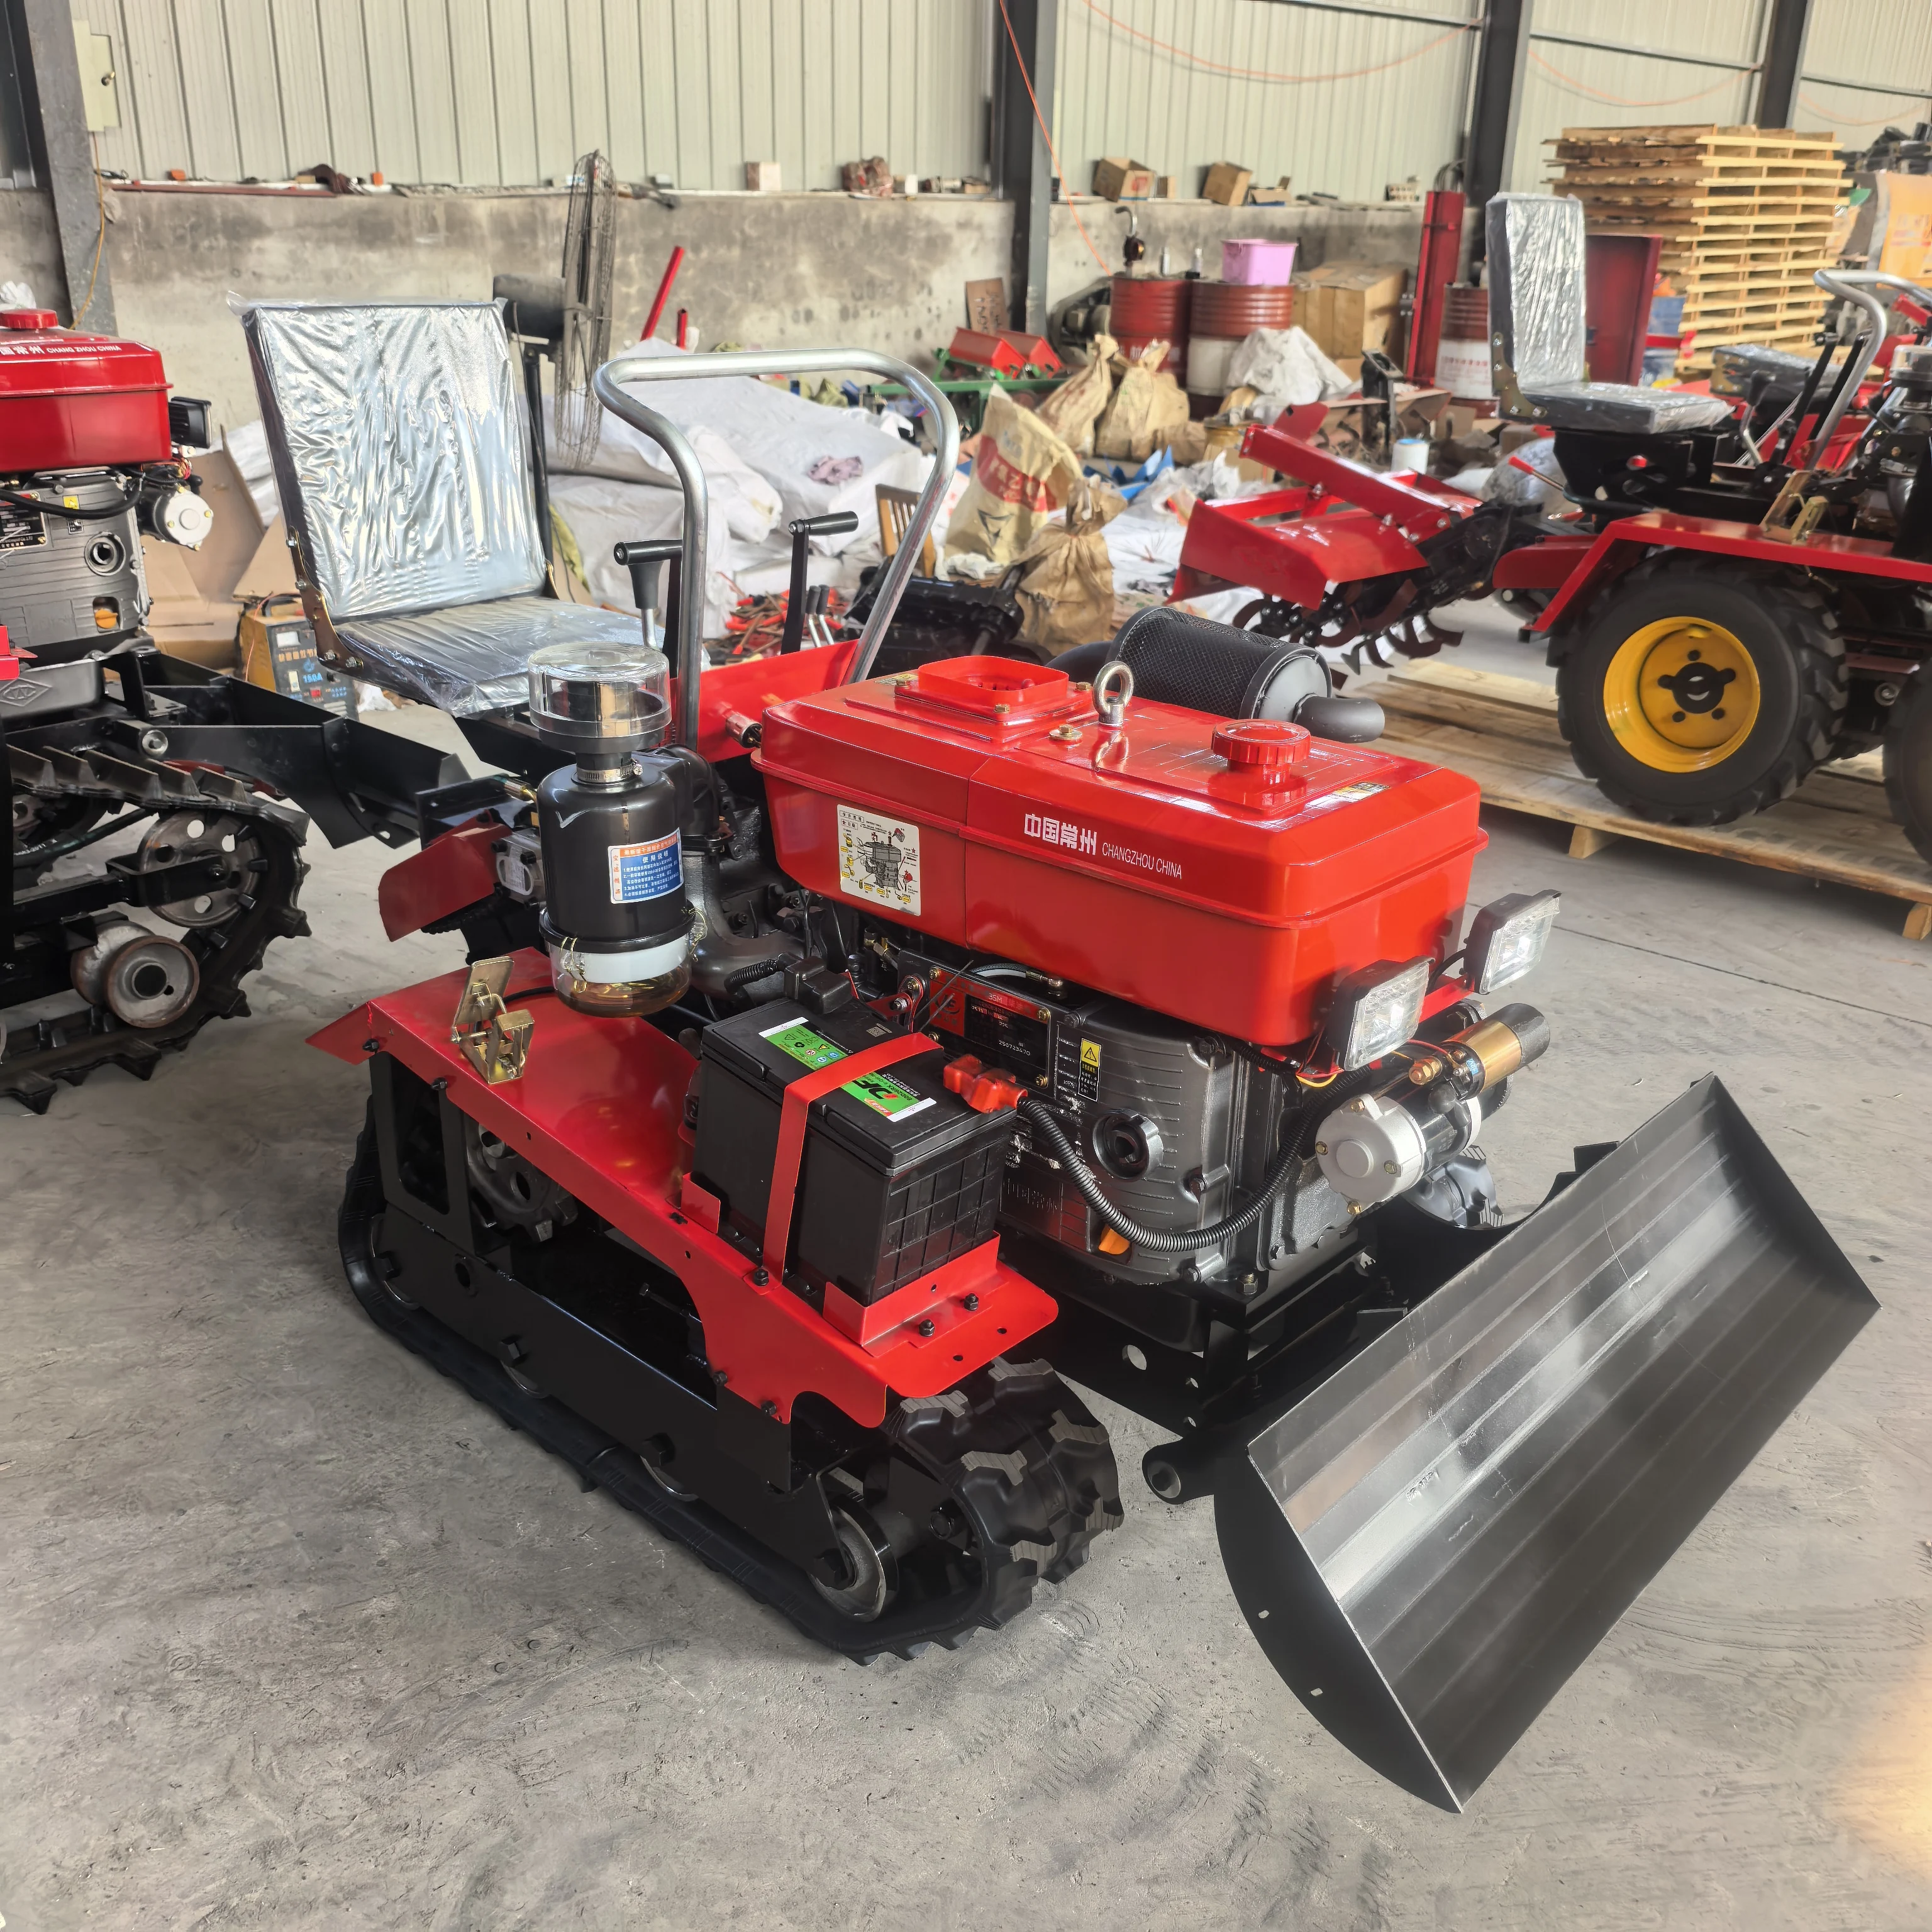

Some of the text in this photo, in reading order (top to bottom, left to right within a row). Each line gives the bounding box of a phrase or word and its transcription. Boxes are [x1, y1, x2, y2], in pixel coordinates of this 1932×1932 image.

[1024, 814, 1097, 855] 中国常州
[642, 850, 669, 863] 使用说明
[1102, 842, 1182, 879] CHANGZHOU CHINA
